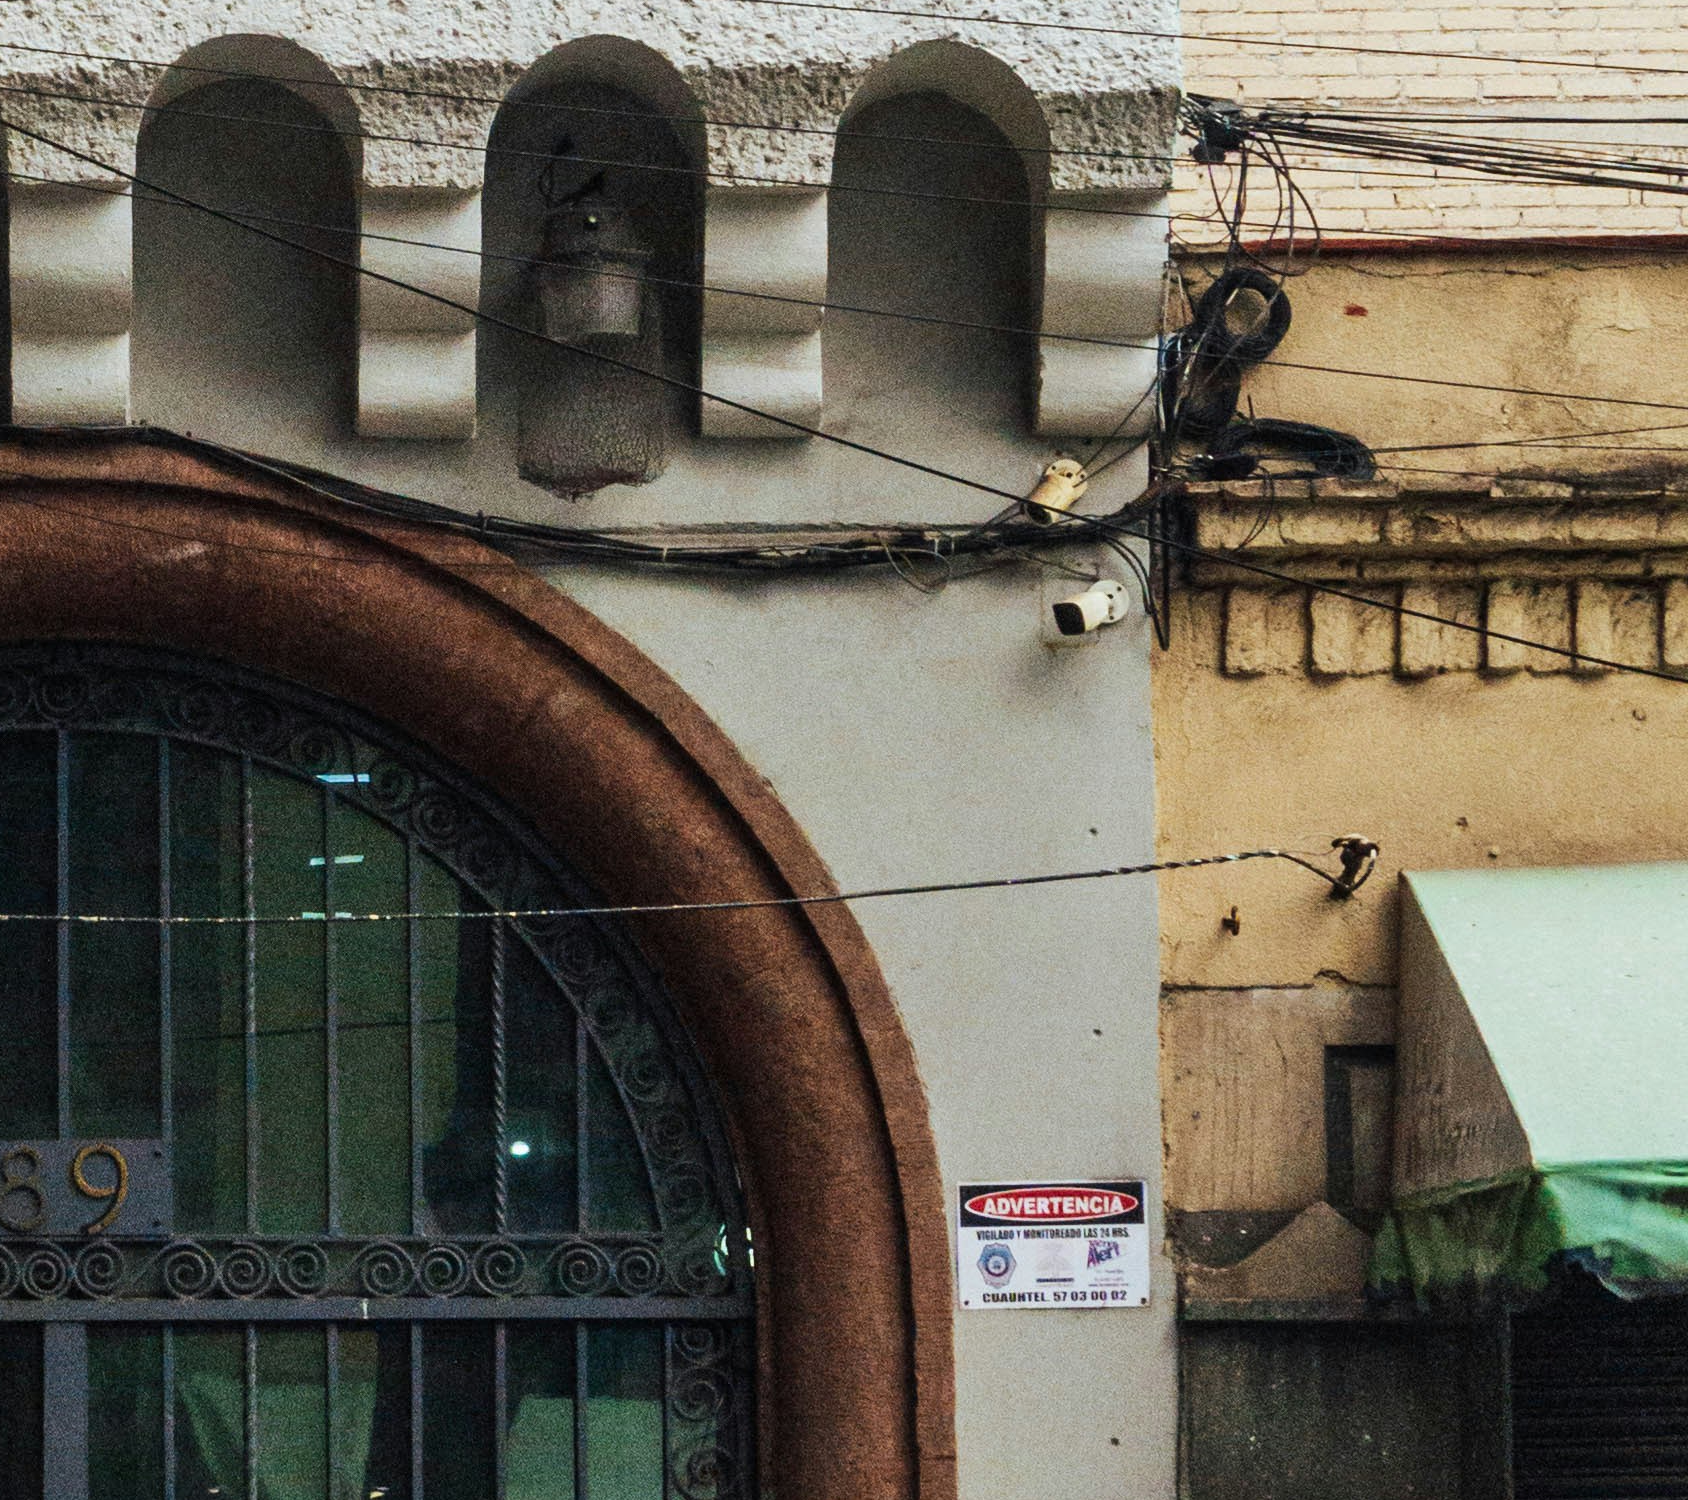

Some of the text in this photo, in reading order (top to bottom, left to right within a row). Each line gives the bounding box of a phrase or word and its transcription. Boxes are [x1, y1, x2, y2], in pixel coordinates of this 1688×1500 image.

[982, 1195, 1125, 1216] ADVERTENCIA
[976, 1229, 1015, 1240] VIGILADO
[1016, 1229, 1022, 1239] Y
[1023, 1228, 1082, 1240] MONITOREADO
[1083, 1227, 1098, 1238] LAS
[1100, 1227, 1111, 1238] 24
[1053, 1291, 1068, 1302] 57
[1070, 1291, 1087, 1302] 03
